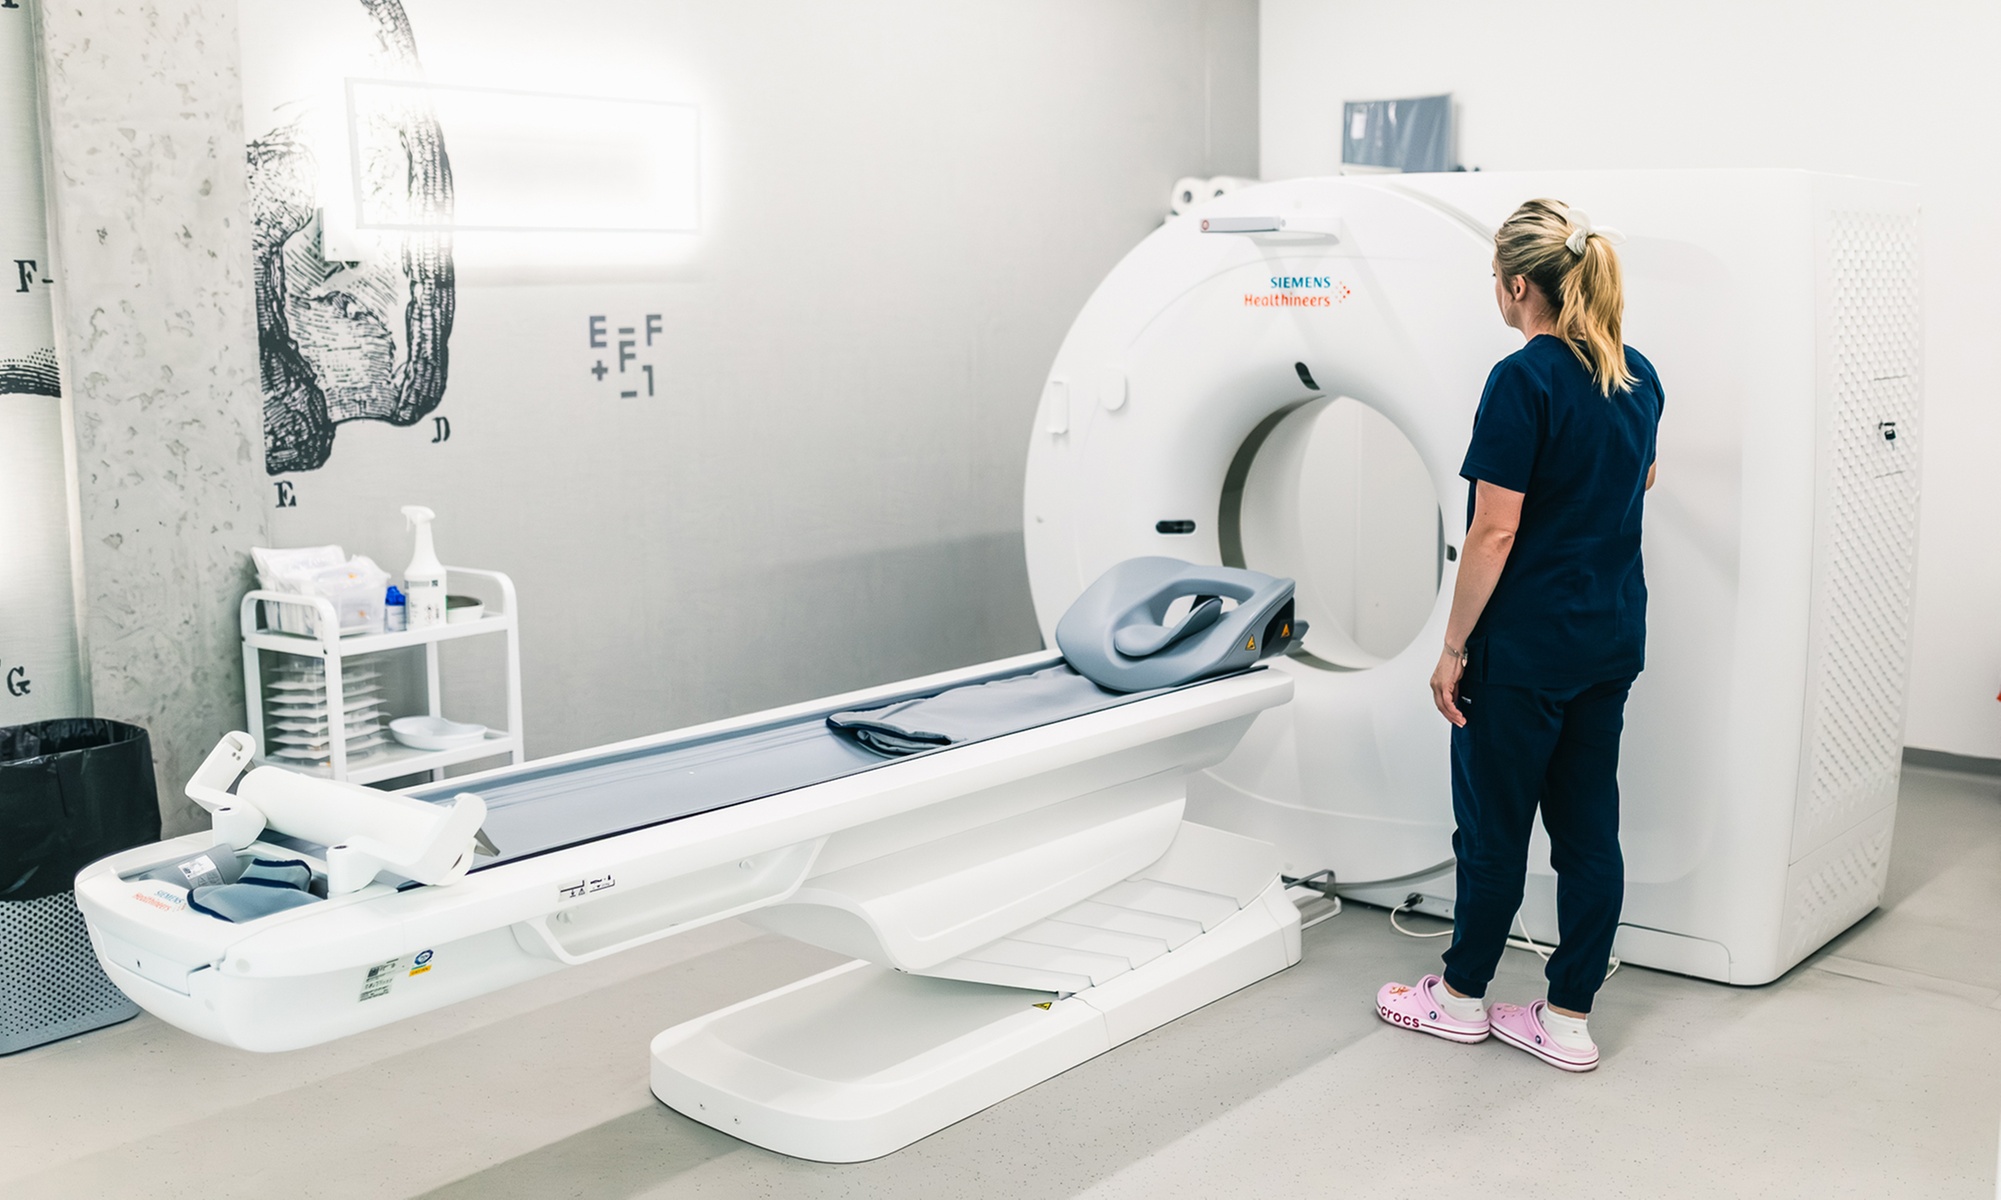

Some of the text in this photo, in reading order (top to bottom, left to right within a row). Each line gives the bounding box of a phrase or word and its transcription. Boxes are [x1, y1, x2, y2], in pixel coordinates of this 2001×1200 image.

[1271, 276, 1331, 289] SIEMENS
[1244, 292, 1331, 307] Healthineers
[431, 416, 451, 443] D
[273, 480, 297, 508] E
[7, 666, 31, 697] G
[1380, 1006, 1420, 1028] crocs
